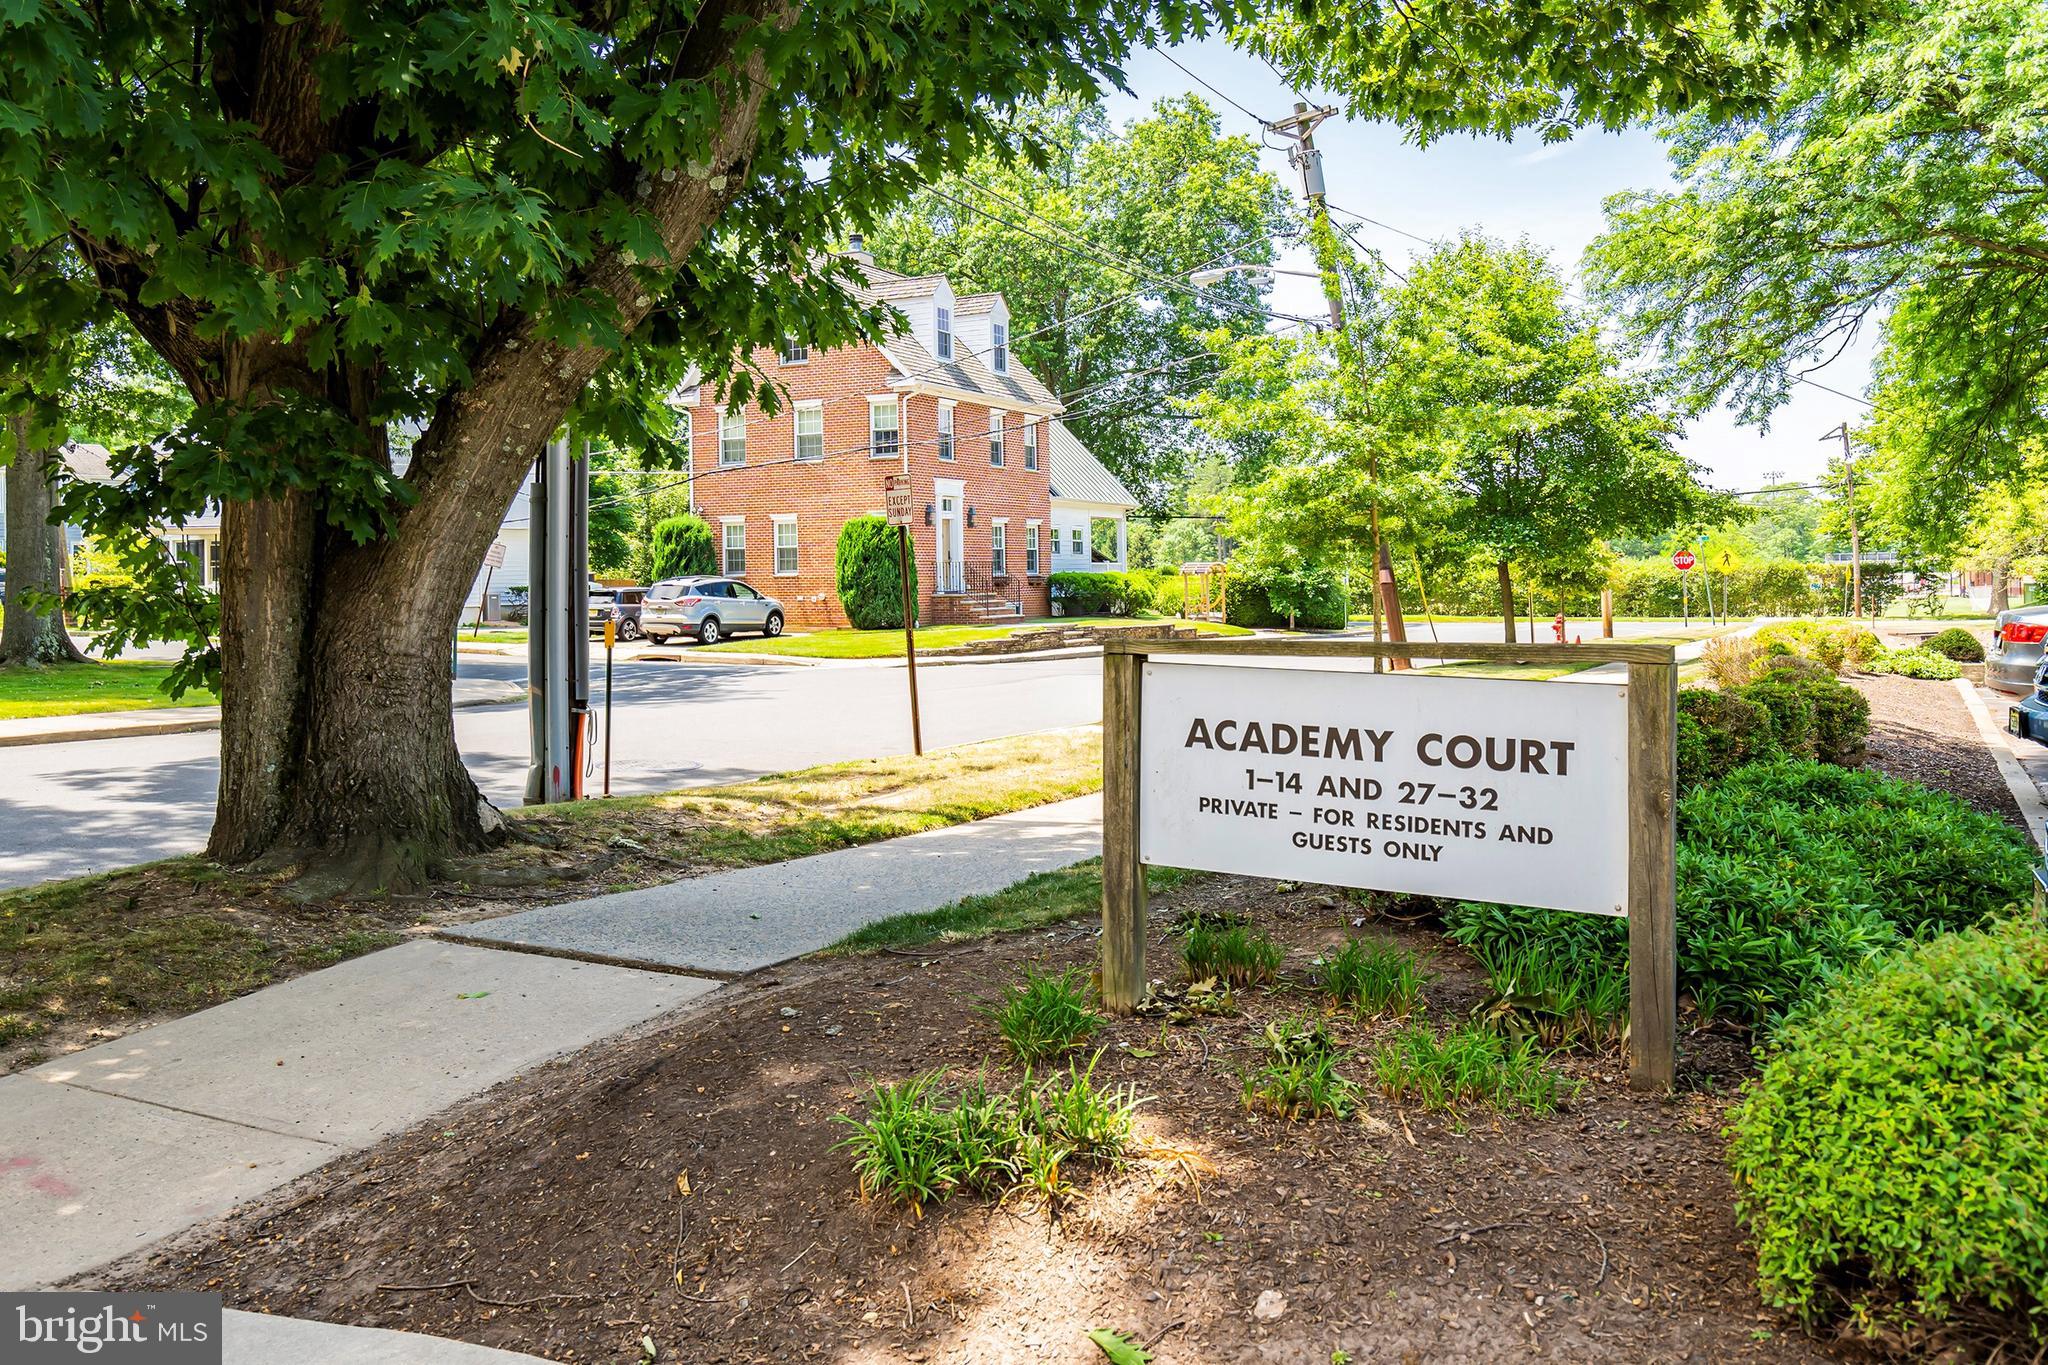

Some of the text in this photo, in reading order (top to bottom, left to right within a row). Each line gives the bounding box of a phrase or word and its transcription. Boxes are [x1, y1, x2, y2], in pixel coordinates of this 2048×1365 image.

[885, 478, 893, 488] NO
[888, 495, 911, 506] EXCEPT
[888, 507, 912, 518] SUNDAY
[1674, 556, 1694, 565] STOP
[1184, 718, 1575, 777] ACADEMY COURT
[1245, 768, 1499, 812] 1-14 AND 27-32
[1199, 796, 1279, 820] PRIVATE
[1313, 807, 1355, 828] FOR
[1366, 812, 1487, 840] RESIDENTS
[1498, 824, 1554, 845] AND
[1292, 831, 1444, 862] GUESTS ONLY
